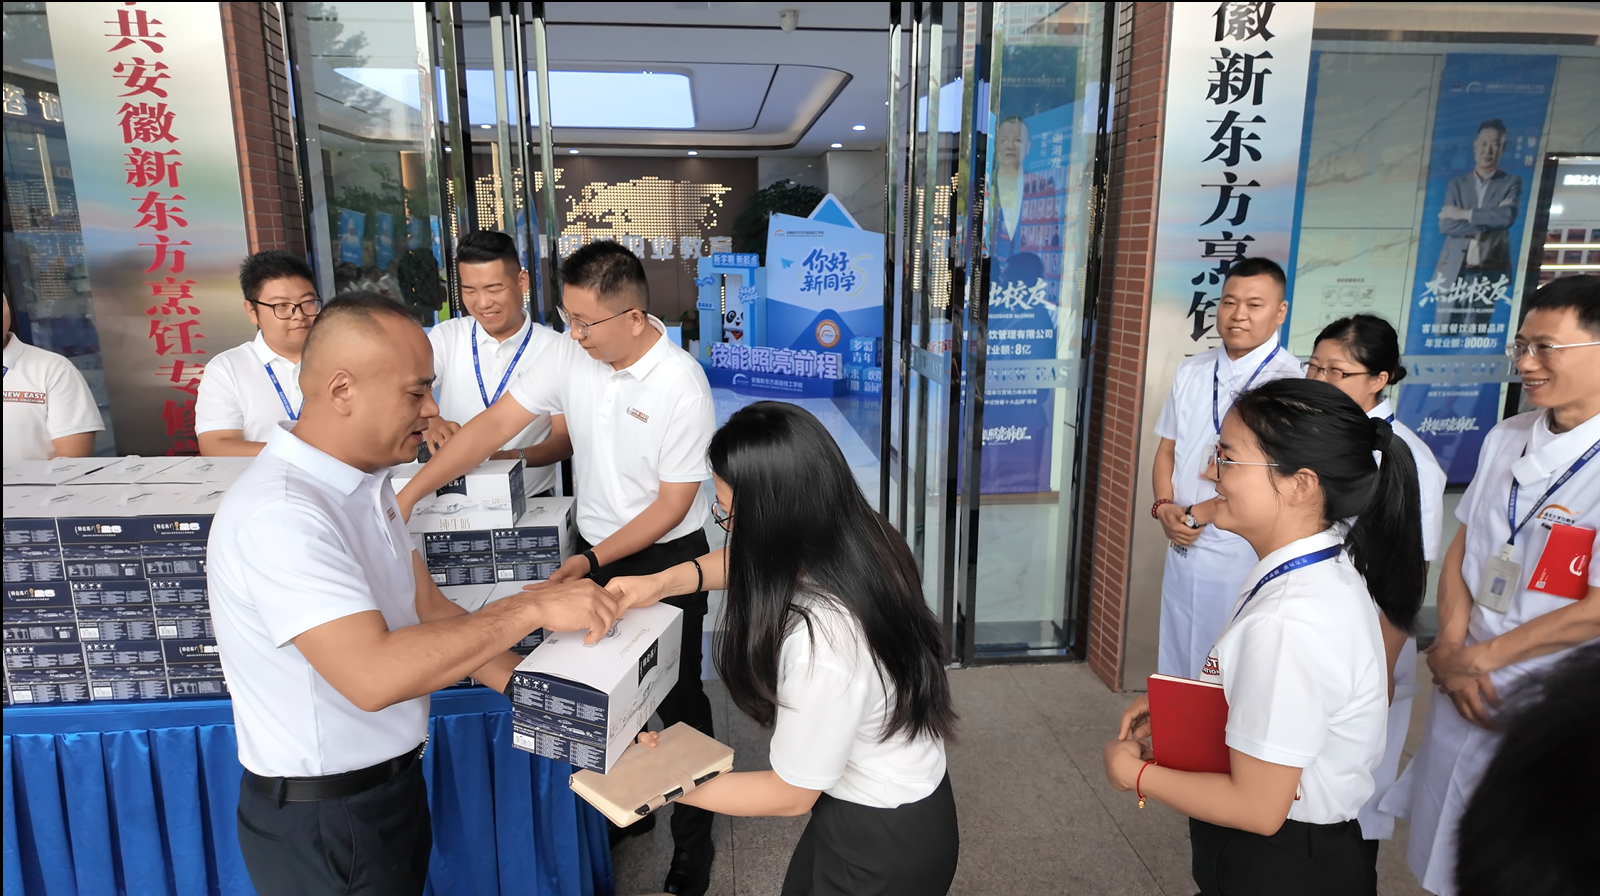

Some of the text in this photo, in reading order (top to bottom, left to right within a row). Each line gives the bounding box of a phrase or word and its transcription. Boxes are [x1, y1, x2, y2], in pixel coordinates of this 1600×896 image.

[1180, 2, 1276, 357] 徽新东方烹饪
[103, 2, 207, 456] 共安徽新东方烹饪专修
[799, 271, 856, 296] 新同学
[1418, 272, 1512, 308] 杰出校友
[711, 344, 837, 380] 技能照亮前程
[1036, 366, 1073, 382] EAS
[24, 392, 45, 400] EAST
[1206, 658, 1218, 668] ST
